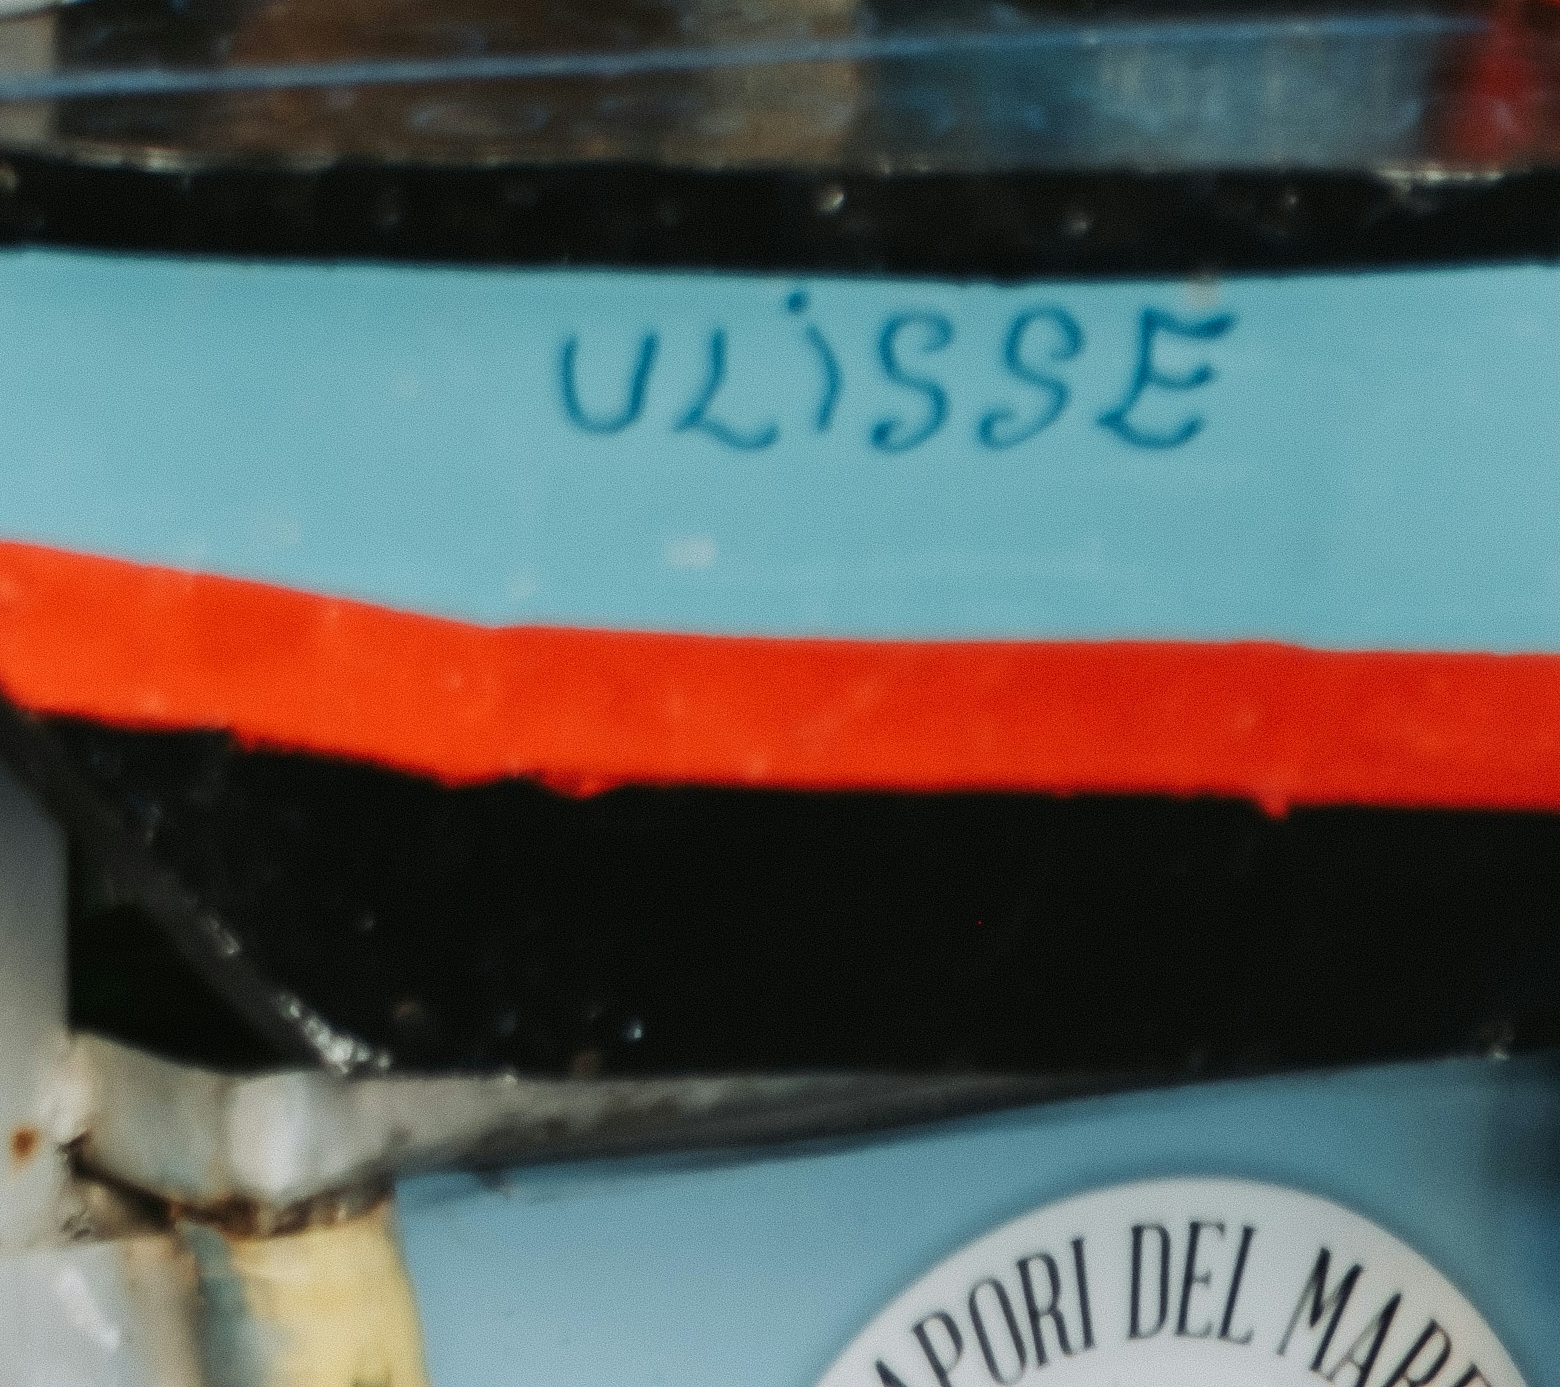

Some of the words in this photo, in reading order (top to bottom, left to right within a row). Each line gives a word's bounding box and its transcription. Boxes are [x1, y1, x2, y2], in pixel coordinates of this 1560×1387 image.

[874, 1237, 1096, 1387] PORI
[1127, 1220, 1257, 1346] DEL
[1275, 1246, 1493, 1387] MAR
